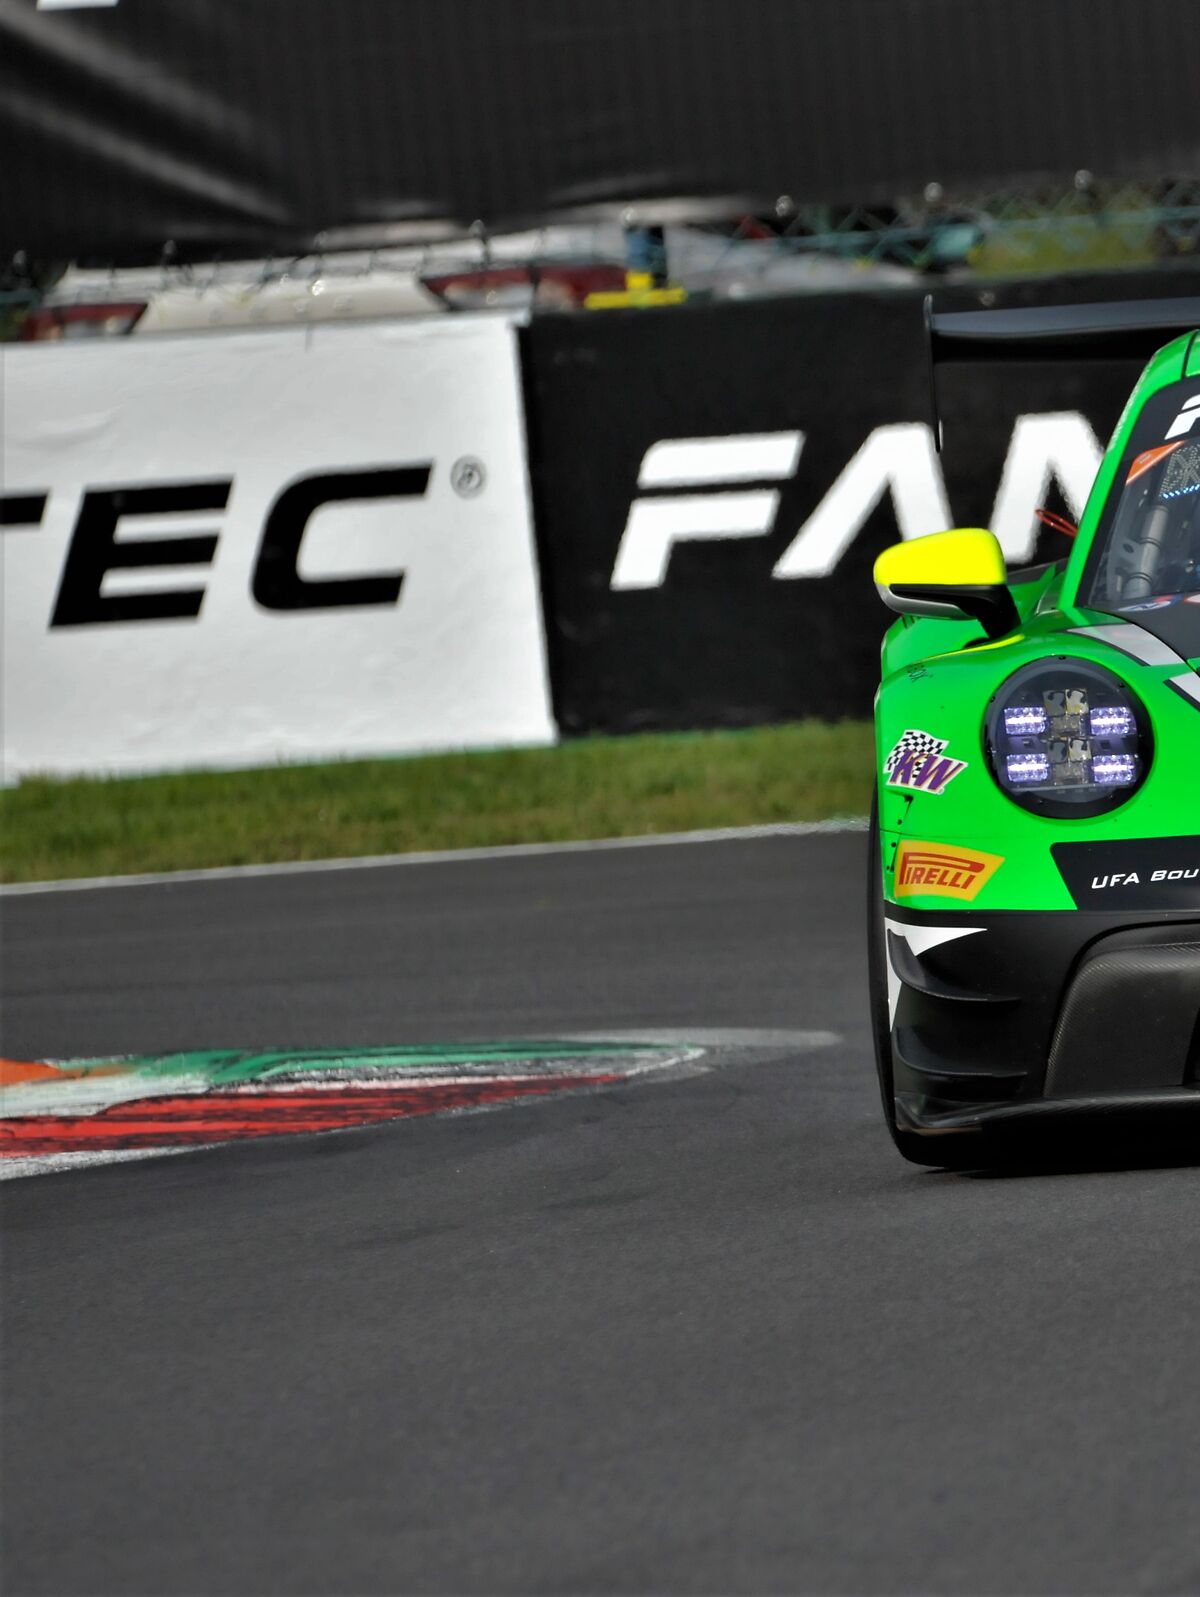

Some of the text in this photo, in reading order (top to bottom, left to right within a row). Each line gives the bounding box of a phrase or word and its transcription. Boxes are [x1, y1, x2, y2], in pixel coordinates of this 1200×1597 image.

[889, 749, 964, 793] KW
[898, 851, 986, 890] PIRELLI
[1090, 871, 1140, 890] UFA
